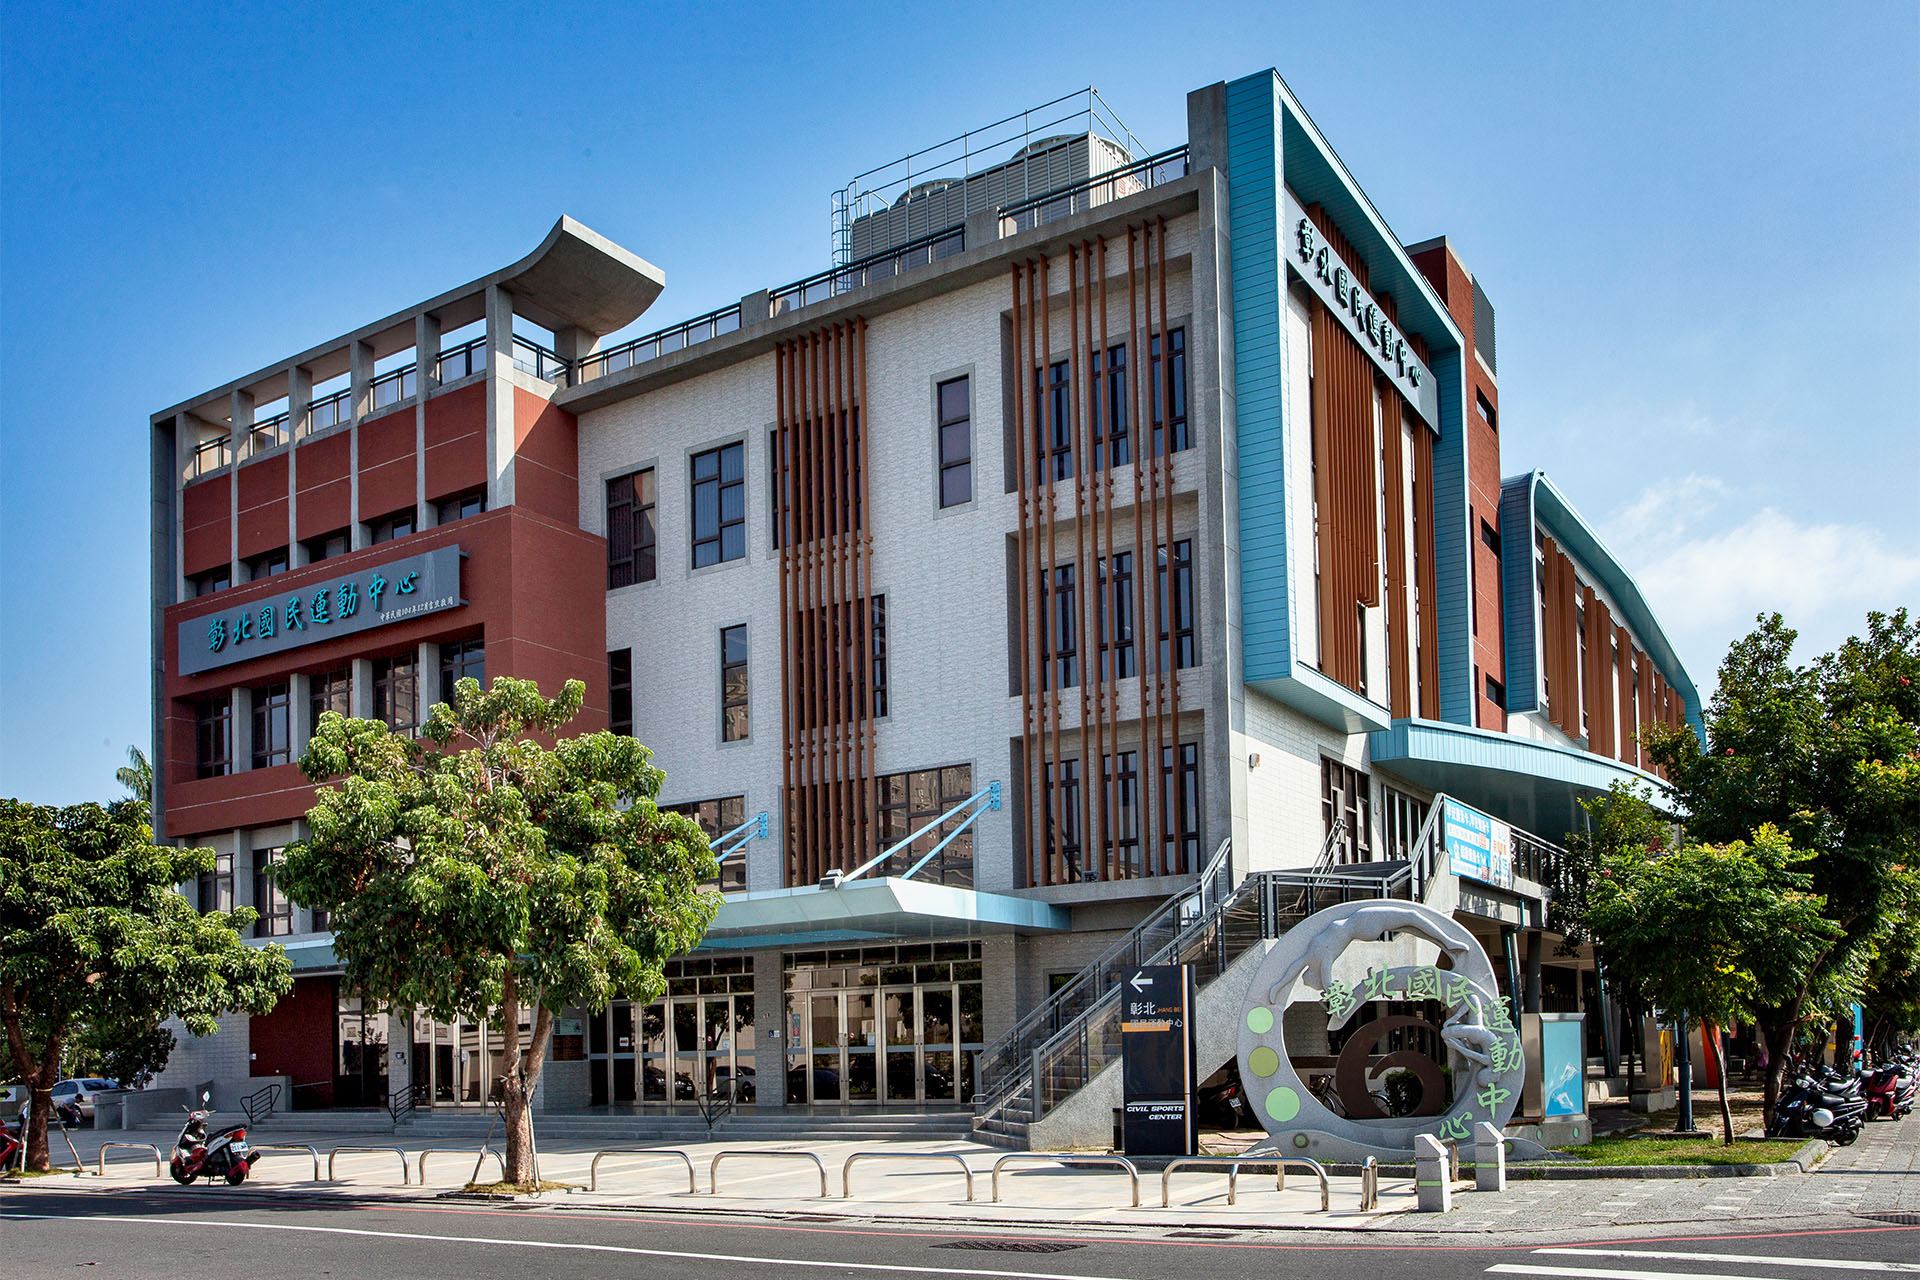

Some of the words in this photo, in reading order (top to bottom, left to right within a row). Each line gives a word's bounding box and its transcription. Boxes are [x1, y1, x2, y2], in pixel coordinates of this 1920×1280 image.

[208, 571, 418, 651] 彰北國民運動中心
[1130, 1002, 1156, 1016] 彰北
[1321, 964, 1523, 1140] 彰北國民運動中心
